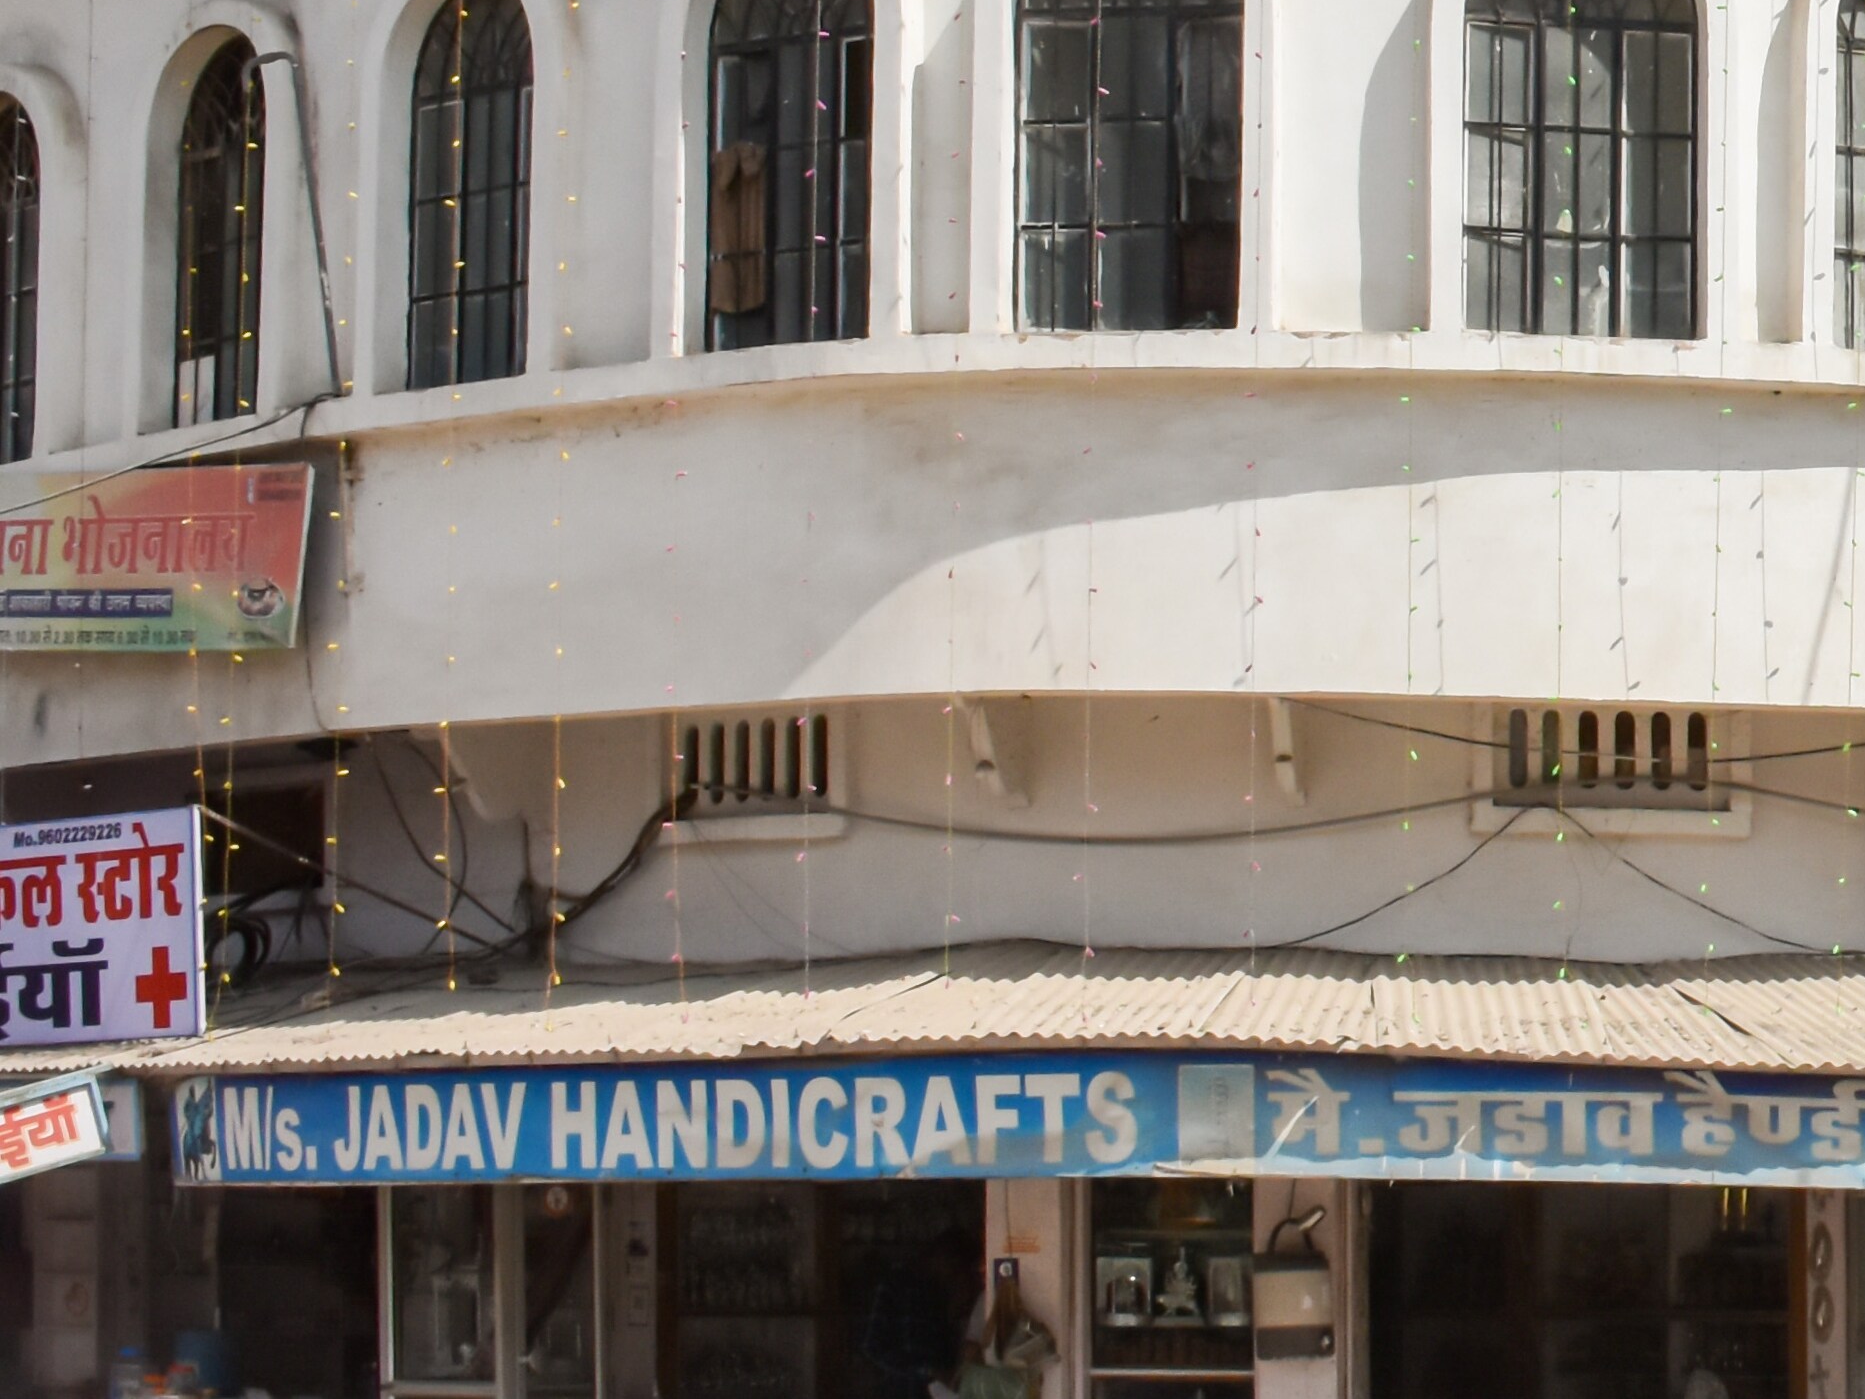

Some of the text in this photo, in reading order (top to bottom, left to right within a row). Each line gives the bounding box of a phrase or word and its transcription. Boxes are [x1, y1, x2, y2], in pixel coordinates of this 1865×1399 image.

[0, 494, 256, 575] ना भोजनालय
[75, 821, 185, 925] स्टोर
[334, 1081, 527, 1171] JADAV
[551, 1070, 1138, 1170] HANDICRAFTS
